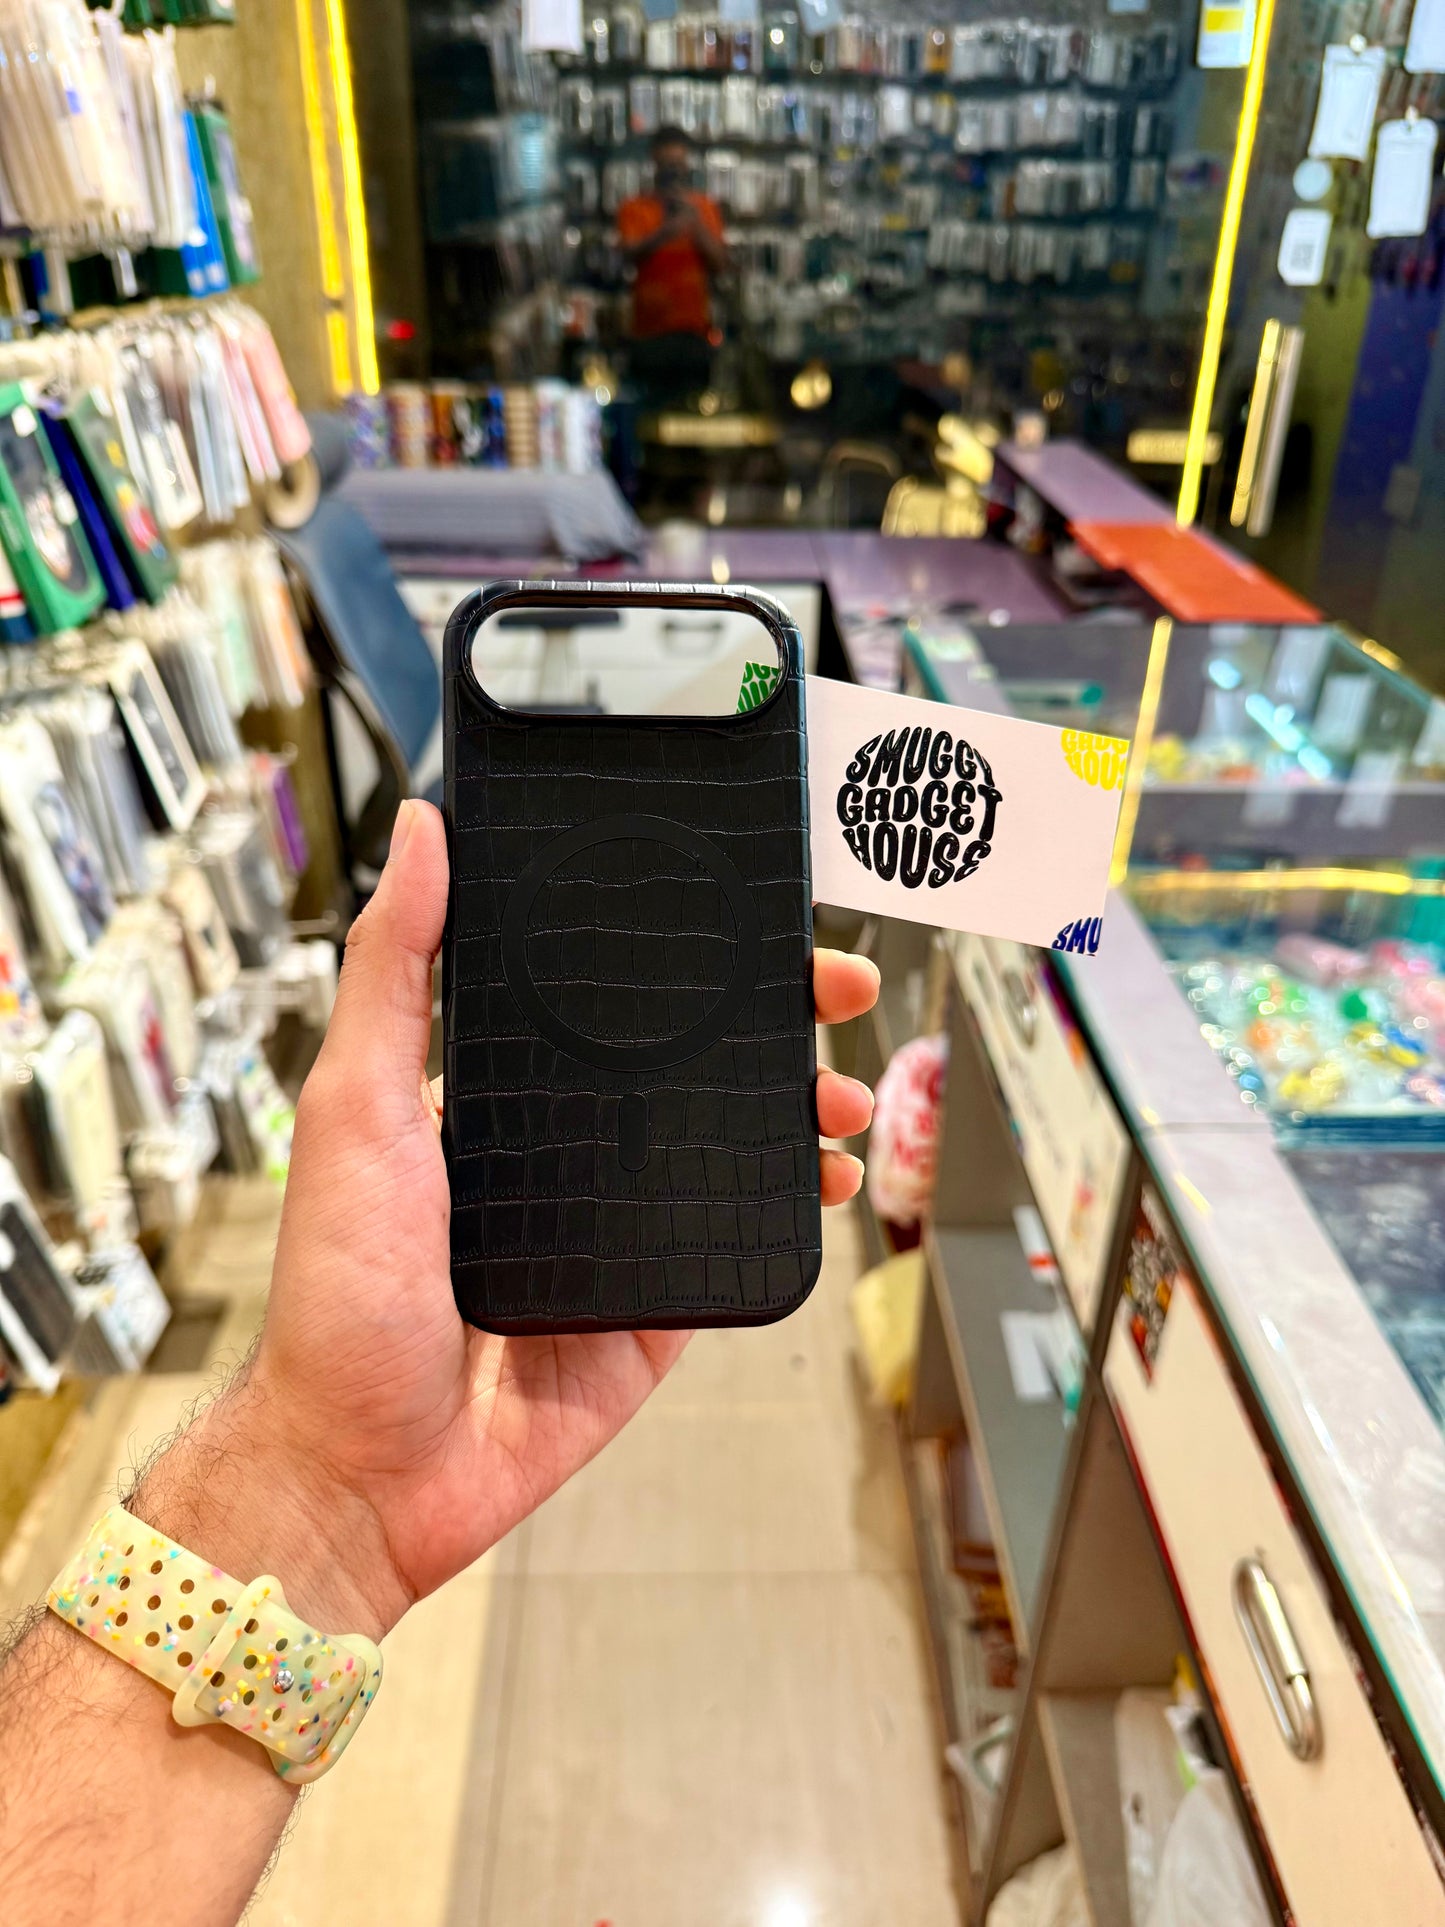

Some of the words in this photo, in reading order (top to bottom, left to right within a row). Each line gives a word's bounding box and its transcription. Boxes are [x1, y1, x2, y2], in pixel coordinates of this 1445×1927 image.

[846, 727, 995, 787] SMUGGY
[837, 779, 1003, 841] GADGET
[842, 822, 991, 889] HOUSE
